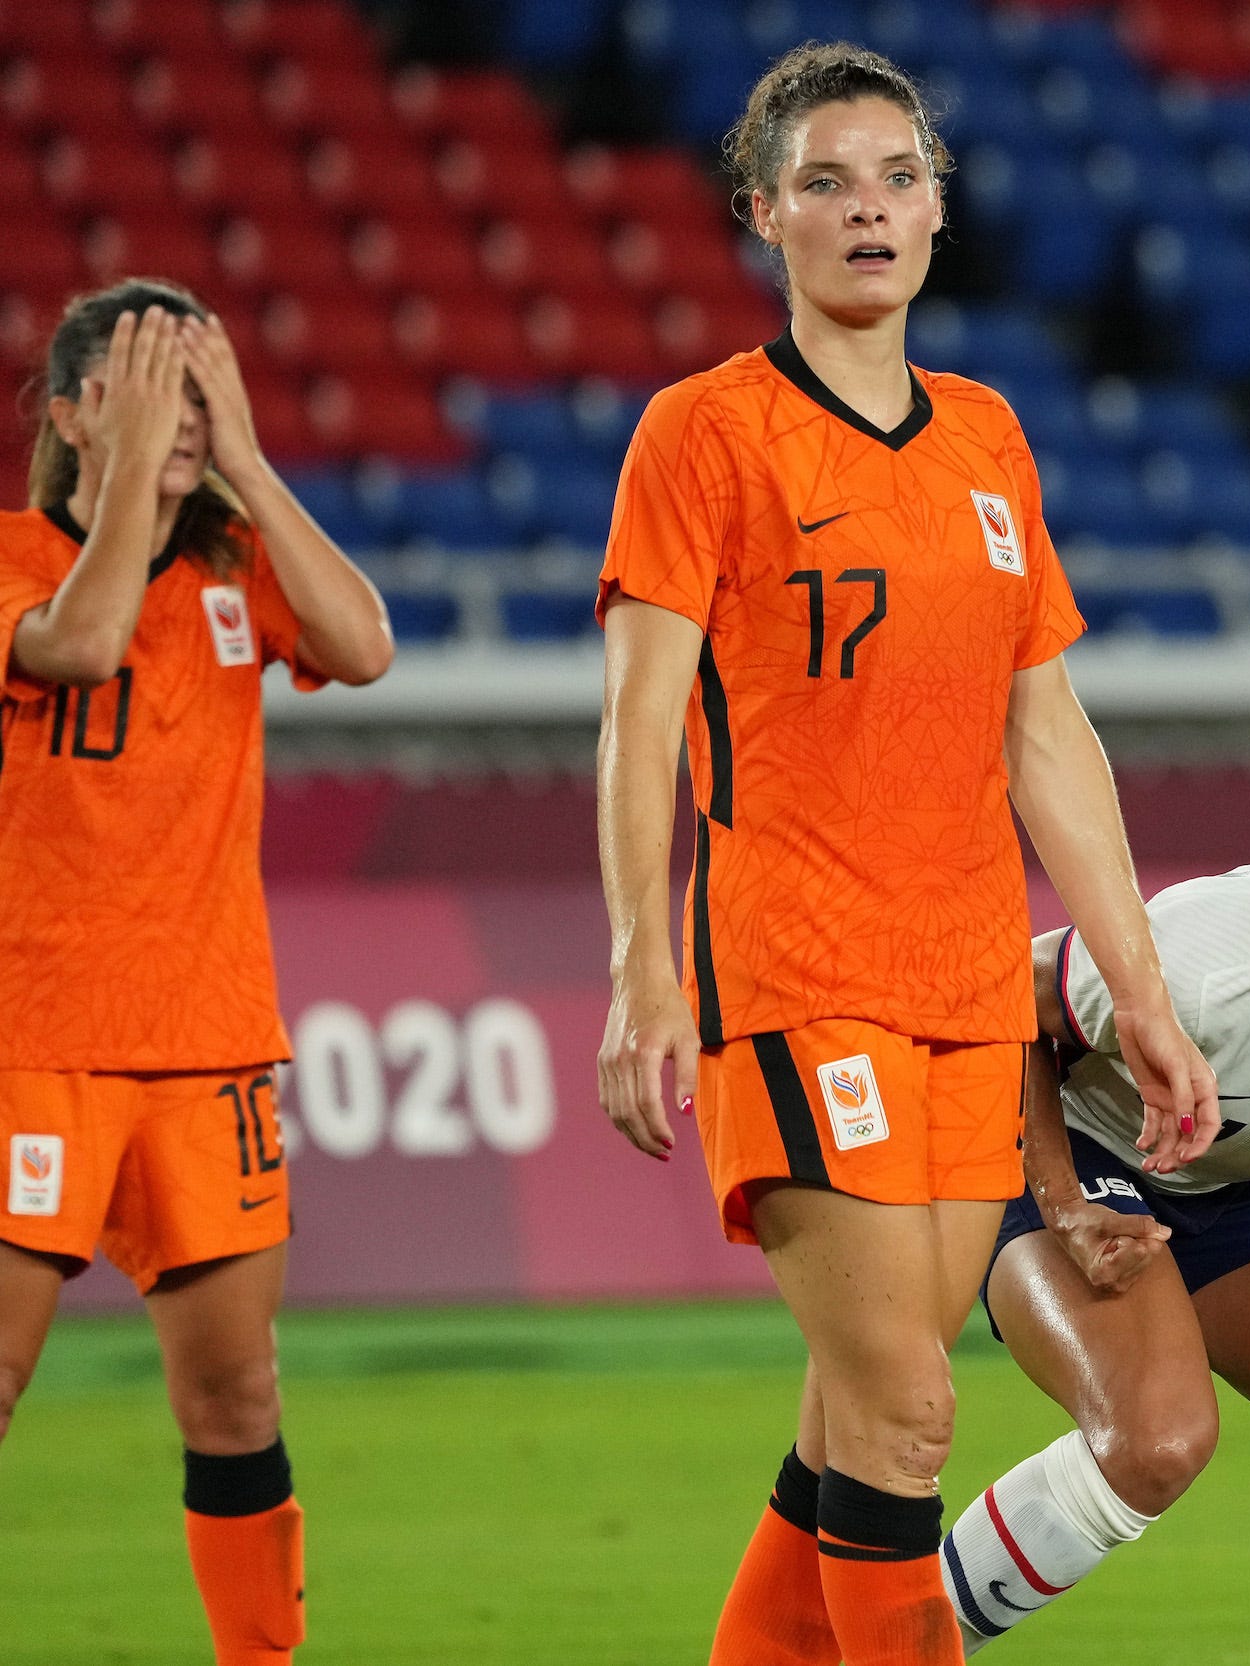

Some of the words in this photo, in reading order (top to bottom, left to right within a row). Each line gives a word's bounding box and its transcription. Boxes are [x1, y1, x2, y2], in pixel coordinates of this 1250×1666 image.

[783, 569, 887, 679] 17
[217, 1073, 284, 1177] 10
[274, 998, 557, 1158] 020
